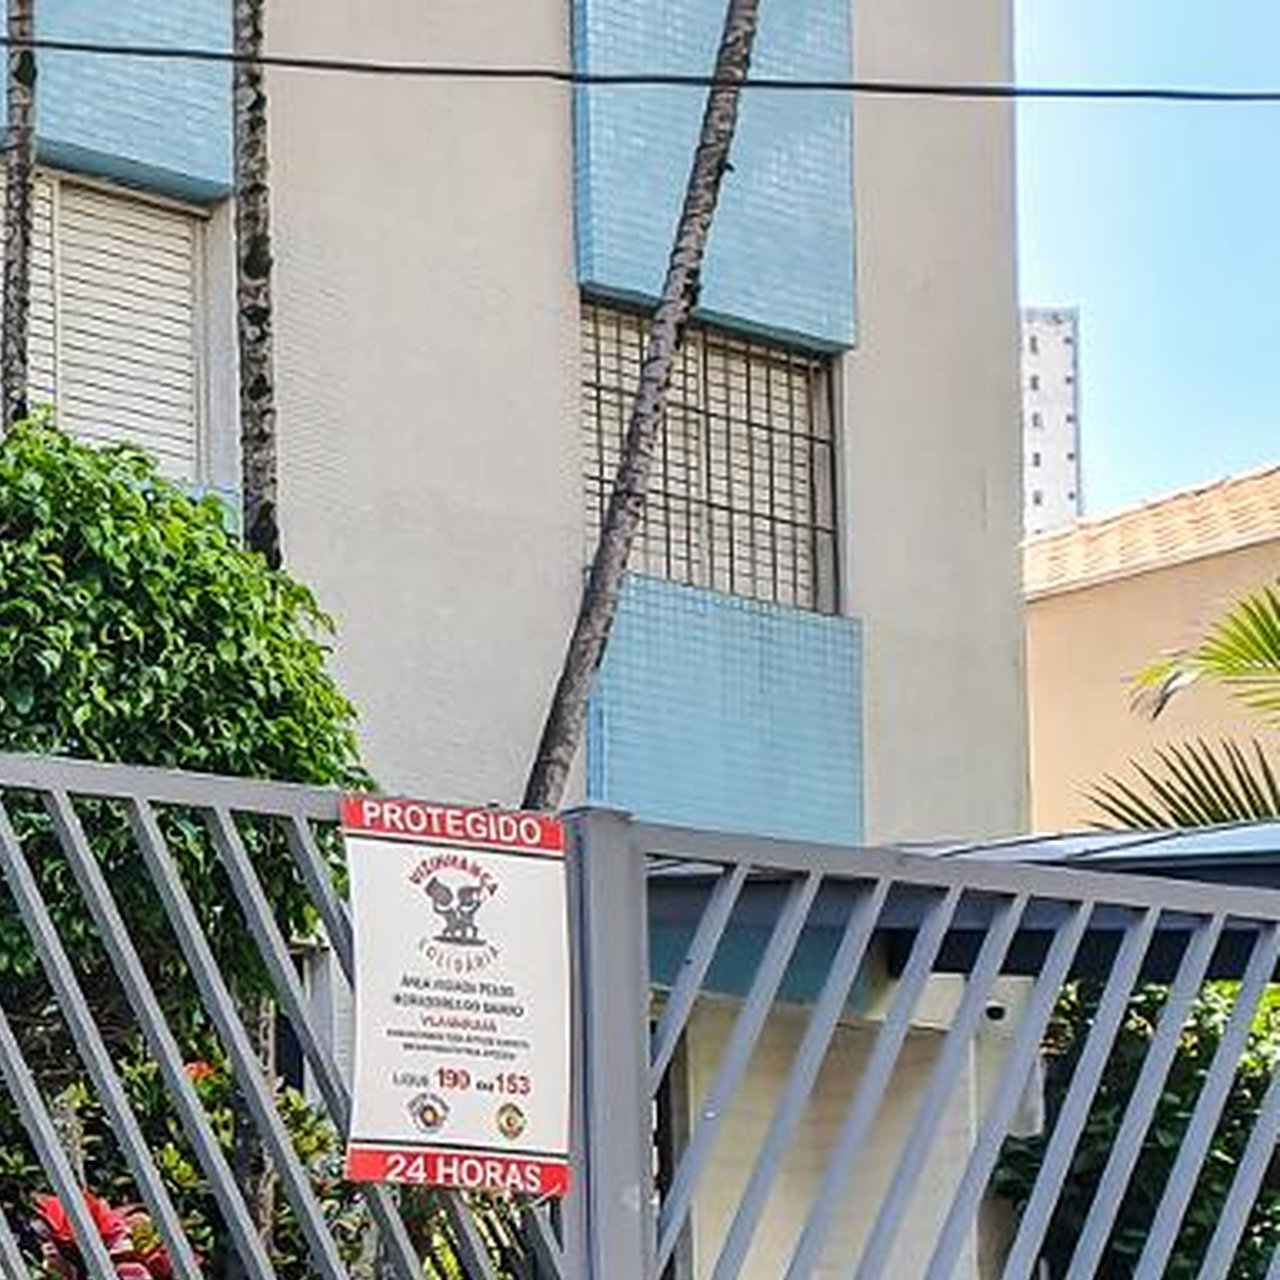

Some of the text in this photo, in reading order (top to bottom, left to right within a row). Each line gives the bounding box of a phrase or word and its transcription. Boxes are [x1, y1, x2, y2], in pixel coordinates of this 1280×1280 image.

[362, 799, 542, 845] PROTEGIDO
[435, 1066, 471, 1091] 190
[386, 1154, 542, 1193] 24 HORAS
